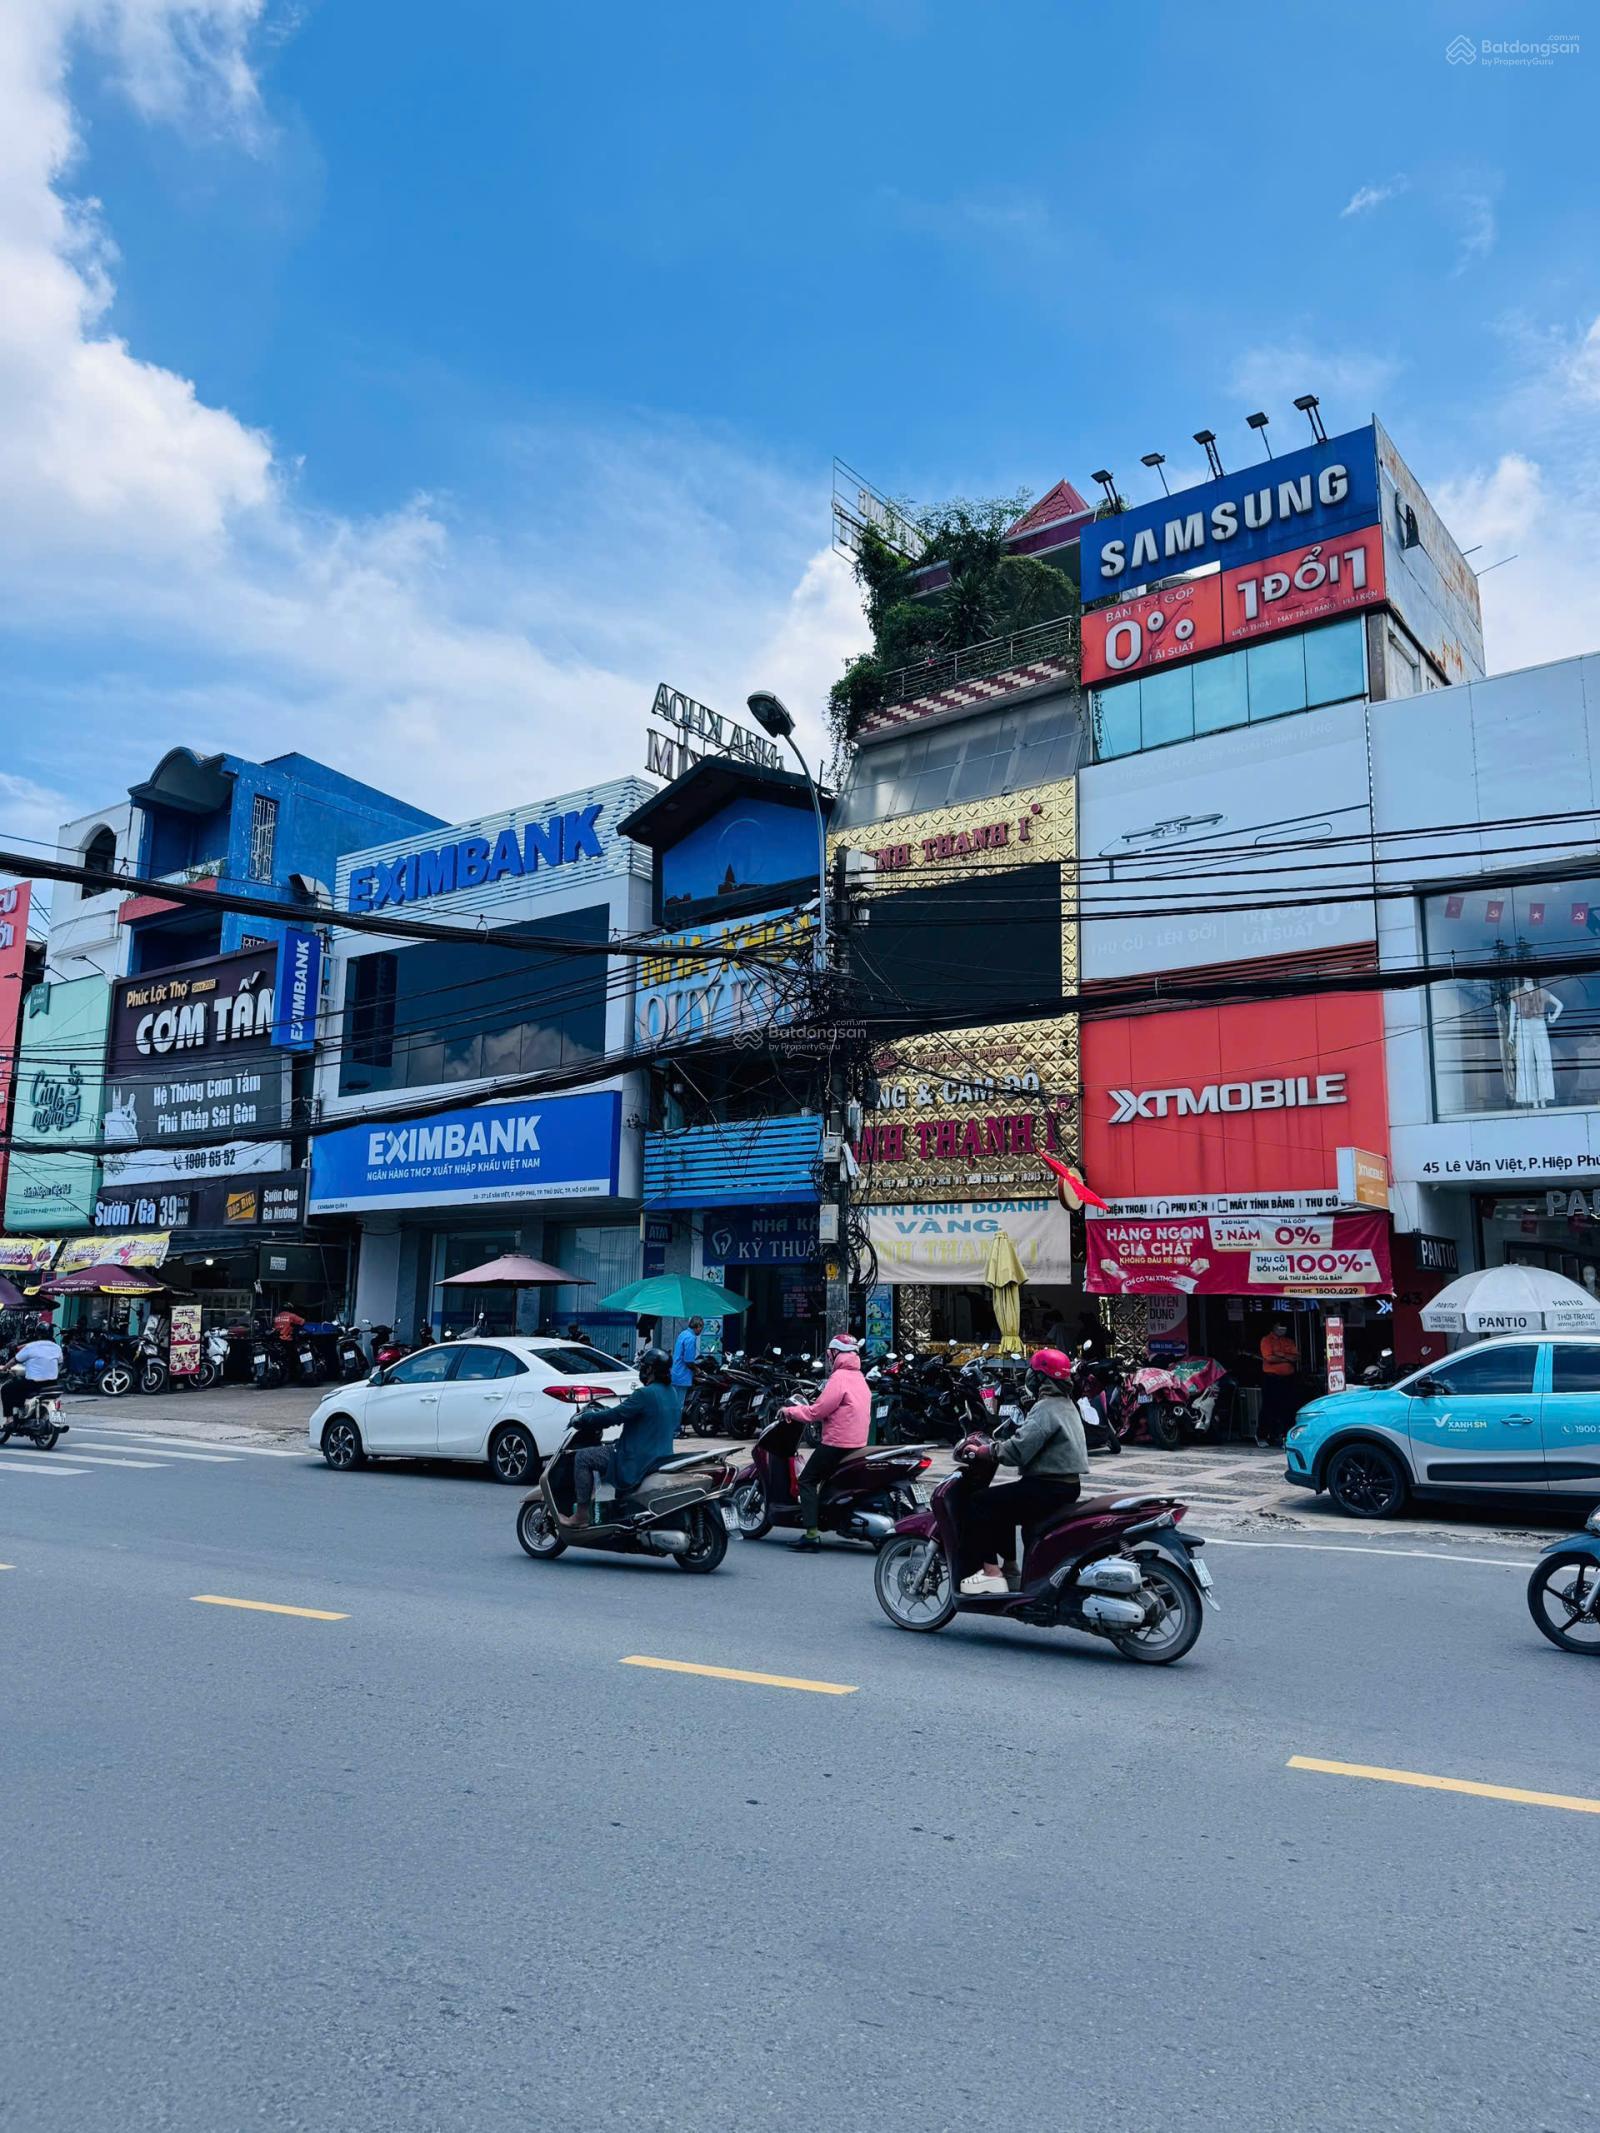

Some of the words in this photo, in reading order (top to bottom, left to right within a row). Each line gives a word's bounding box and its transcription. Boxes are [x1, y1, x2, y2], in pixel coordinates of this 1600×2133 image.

[1100, 463, 1349, 578] SAMSUNG
[348, 804, 605, 914] EXIMBANK
[126, 987, 149, 1009] Phúc
[150, 984, 167, 1004] Lộc
[169, 981, 188, 1000] Thọ
[290, 939, 311, 1042] EXIMBANK
[136, 1001, 208, 1055] CƠM
[153, 1086, 168, 1108] Hệ
[171, 1078, 204, 1104] Thống
[207, 1076, 233, 1099] Cơm
[235, 1069, 261, 1094] Tấm
[915, 1082, 934, 1107] &
[1107, 1073, 1348, 1125] XTMOBILE
[157, 1112, 178, 1135] Phủ
[181, 1106, 209, 1131] Khắp
[212, 1104, 231, 1127] Sài
[233, 1102, 257, 1124] Gòn
[367, 1115, 541, 1166] EXIMBANK
[185, 1151, 206, 1170] 1900
[208, 1150, 221, 1168] 65
[223, 1148, 236, 1166] 52
[1422, 1161, 1440, 1174] 45
[1445, 1159, 1463, 1173] Lê
[1466, 1159, 1492, 1172] Văn
[1495, 1157, 1527, 1173] Việt,
[366, 1169, 387, 1182] NGÂN
[388, 1167, 409, 1180] HÀNG
[410, 1167, 431, 1178] TMCP
[432, 1163, 453, 1176] XUẤT
[454, 1161, 477, 1177] NHẬP
[501, 1156, 521, 1174] VIỆT
[521, 1157, 541, 1169] NAM
[264, 1189, 283, 1203] Sườn
[283, 1188, 299, 1201] Que
[94, 1200, 130, 1227] Sườn
[263, 1207, 273, 1220] Gà
[912, 1203, 963, 1216] KINH
[971, 1201, 1049, 1214] DOANH
[1126, 1204, 1148, 1216] THOẠI
[1171, 1202, 1188, 1213] PHỤ
[1188, 1200, 1208, 1213] KIN
[1229, 1199, 1248, 1210] MÁY
[1250, 1197, 1271, 1210] TÍNH
[1272, 1195, 1295, 1209] BẢNG
[1306, 1197, 1324, 1208] THU
[1325, 1195, 1339, 1207] CŨ
[752, 1219, 788, 1233] NHA
[895, 1218, 1000, 1234] VÀNG
[1106, 1225, 1152, 1241] HÀNG
[1156, 1226, 1205, 1240] NGON
[1214, 1230, 1223, 1241] 3
[1227, 1226, 1261, 1241] NĂM
[1274, 1226, 1321, 1245] 0%
[738, 1237, 763, 1259] KỸ
[1118, 1239, 1147, 1256] GIÁ
[1421, 1238, 1457, 1269] PANTIO
[1273, 1254, 1286, 1263] CŨ
[1318, 1273, 1330, 1281] GIÁ
[1315, 1287, 1359, 1295] 1800.6229
[1552, 1299, 1584, 1307] PANTIO
[1478, 1317, 1528, 1328] PANTIO
[1572, 1312, 1596, 1321] TRANG
[1448, 1420, 1474, 1429] XANH
[1474, 1420, 1488, 1429] SM
[1575, 1424, 1597, 1434] 1900
